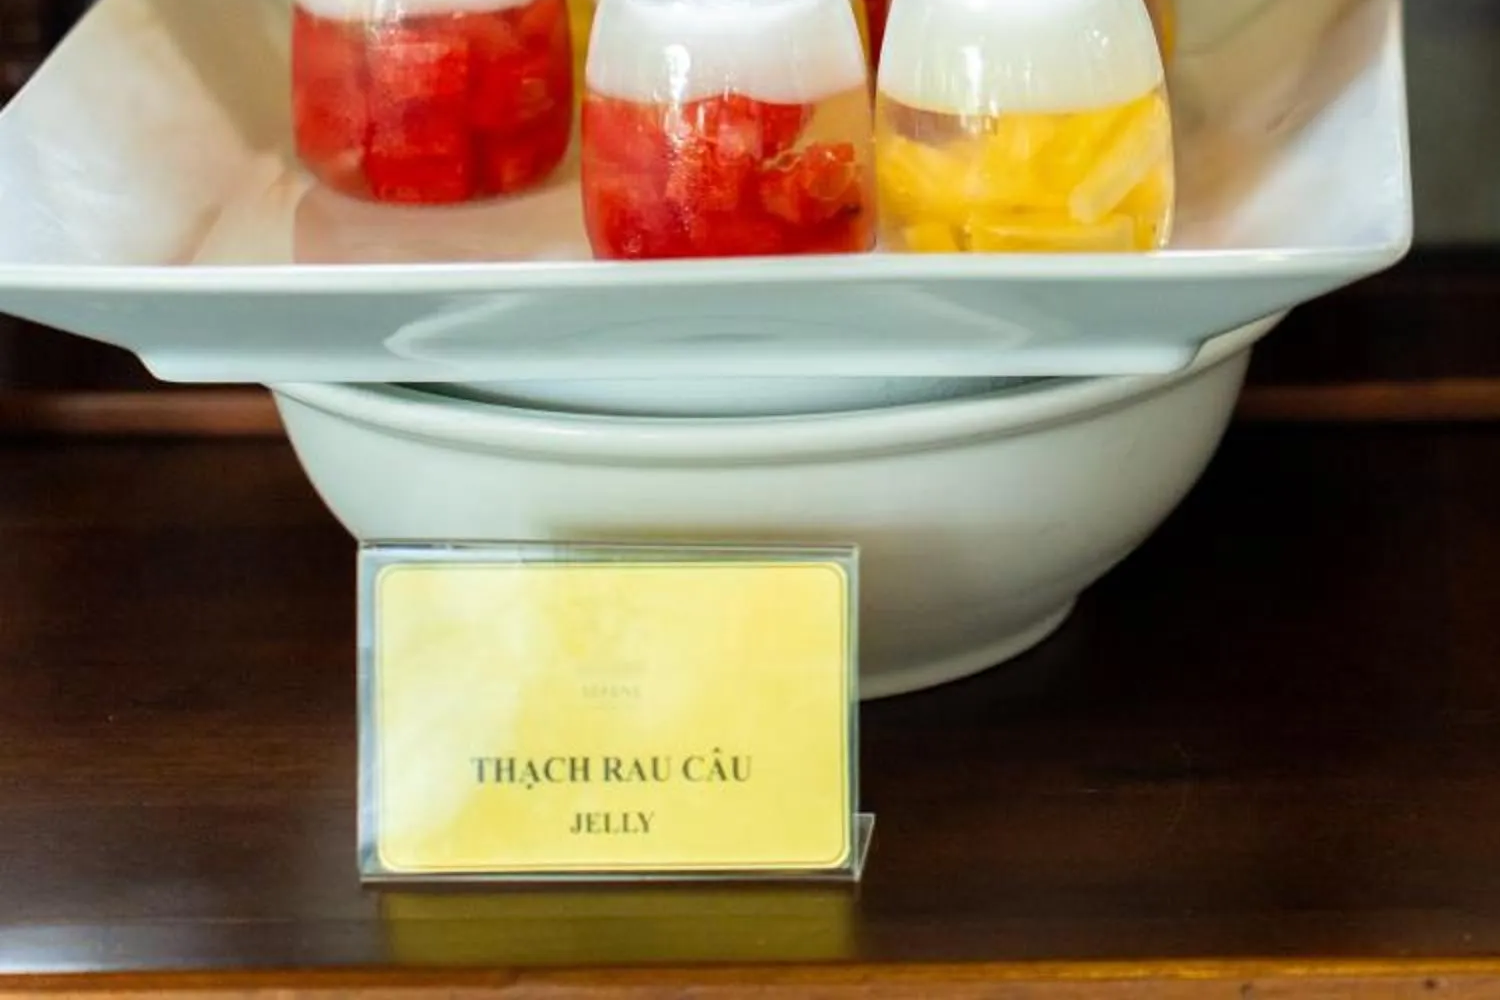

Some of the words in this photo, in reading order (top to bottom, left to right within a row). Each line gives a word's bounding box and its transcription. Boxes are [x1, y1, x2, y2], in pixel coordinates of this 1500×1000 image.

[470, 755, 592, 790] THẠCH
[602, 755, 672, 783] RAU
[682, 746, 753, 783] CÂU
[569, 811, 655, 835] JELLY
